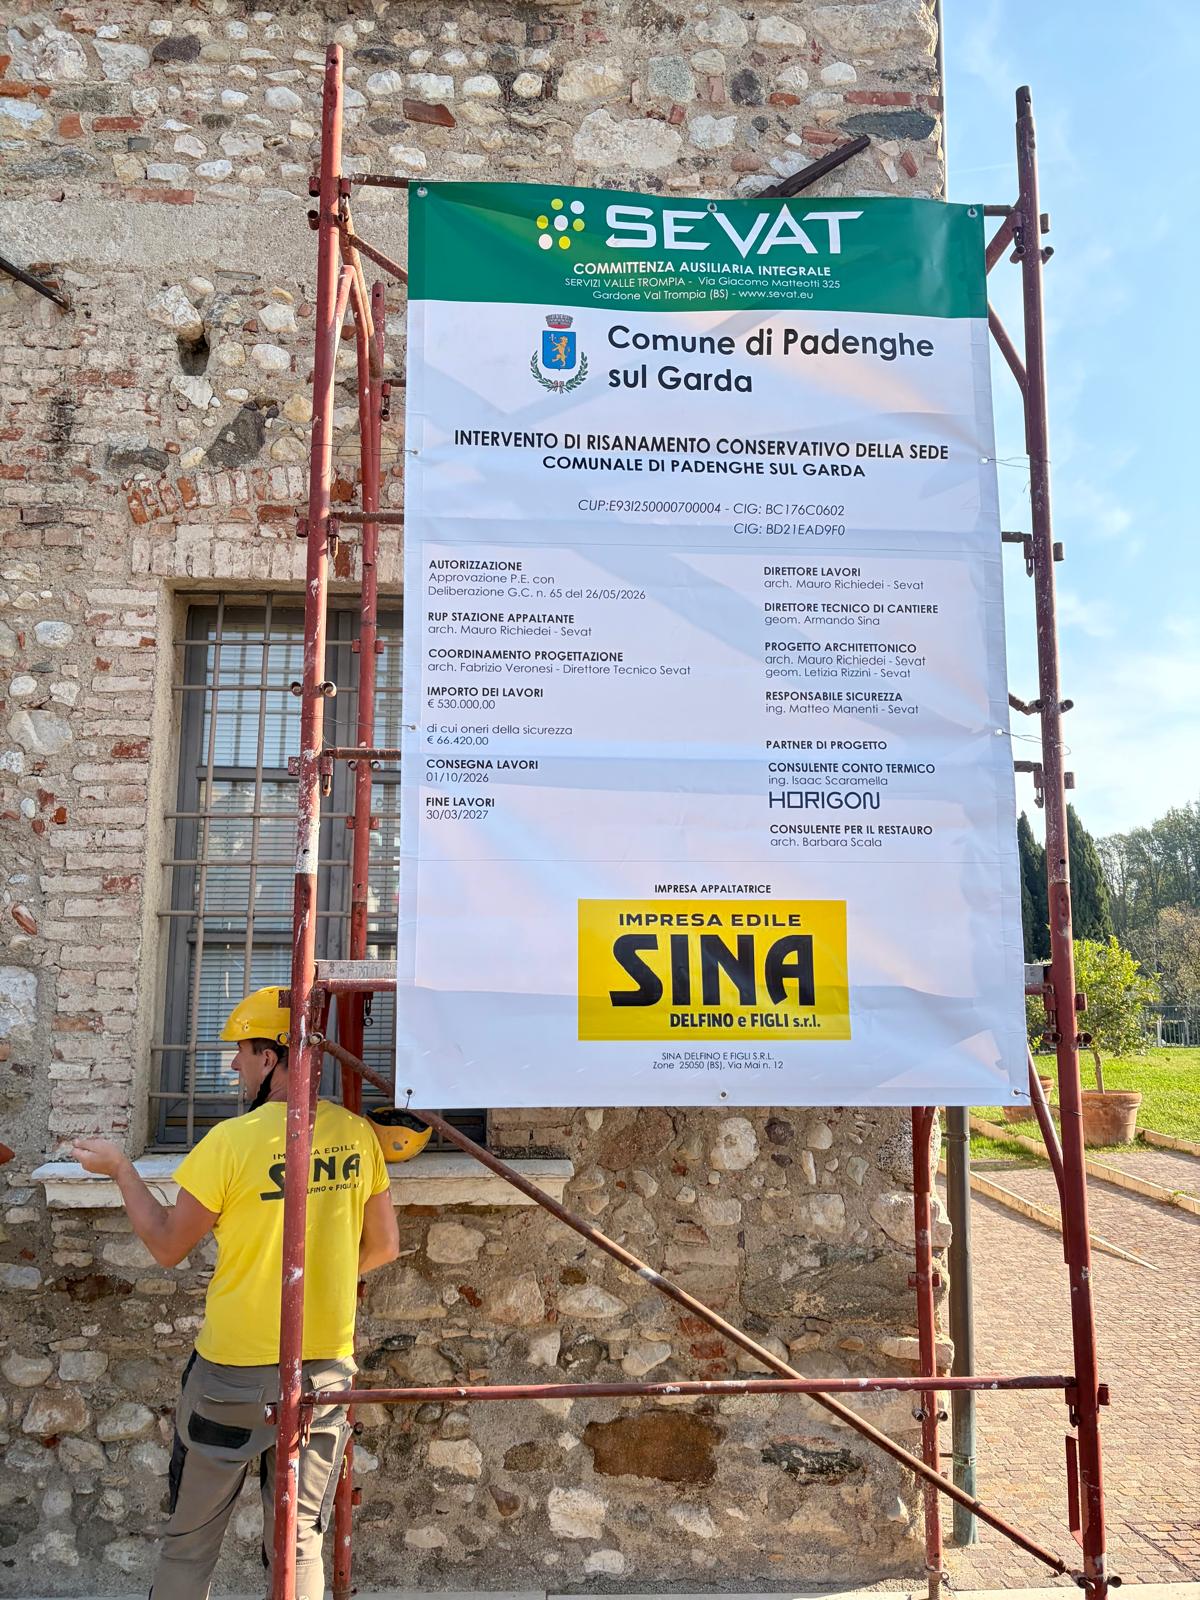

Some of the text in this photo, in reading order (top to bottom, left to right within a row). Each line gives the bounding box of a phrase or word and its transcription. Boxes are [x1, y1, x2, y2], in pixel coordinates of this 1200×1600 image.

[606, 203, 864, 258] SEVAT
[574, 262, 830, 276] COMMITTENZA AUSILIARIA INTEGRALE
[565, 278, 600, 287] SERVIZI
[604, 278, 635, 287] VALLE
[638, 277, 685, 287] TROMPIA
[698, 277, 715, 285] Via
[719, 277, 768, 286] Giacomo
[823, 280, 840, 288] 325
[593, 289, 813, 300] Gardone Val Trompia (BS) www.sevat.eu
[608, 325, 934, 361] Comune di Padenghe
[609, 364, 752, 392] sul Garda
[455, 430, 948, 459] INTERVENTO DI RISANAMENTO CONSERVATIVO DELLA SEDE
[543, 456, 865, 477] COMUNALE DI PADENGHE SUL GARDA
[734, 503, 761, 514] CIG:
[766, 504, 844, 515] BC176C0602
[734, 523, 845, 536] CIG: BD21EAD9F0
[429, 560, 522, 571] AUTORIZZAZIONE
[764, 567, 860, 576] DIRETTORE LAVORI
[429, 573, 507, 583] Approvazione
[511, 574, 529, 583] P.E.
[764, 579, 923, 589] arch. Mauro Richiedei Sevat
[428, 586, 504, 596] Deliberazione
[508, 588, 532, 597] G.C.
[550, 589, 562, 598] 65
[566, 589, 582, 598] del
[586, 589, 645, 599] 26/05/2026
[765, 603, 938, 613] DIRETTORE TECNICO DI CANTIERE
[428, 612, 574, 623] RUP STAZIONE APPALTANTE
[765, 616, 879, 626] geom. Armando Sina
[428, 625, 591, 636] arch. Mauro Richiedei Sevat
[765, 642, 916, 653] PROGETTO ARCHITETTONICO
[429, 649, 623, 662] COORDINAMENTO PROGETTAZIONE
[765, 655, 925, 666] arch. Mauro Richiedei Sevat
[428, 662, 690, 675] arch. Fabrizio Veronesi Direttore Tecnico Sevat
[766, 668, 910, 678] geom. Letizia Rizzini Sevat
[428, 687, 543, 697] IMPORTO DEI LAVORI
[766, 692, 902, 701] RESPONSABILE SICUREZZA
[428, 699, 495, 709] € 530.000,00
[766, 704, 918, 715] ing. Matteo Manenti Sevat
[427, 724, 572, 735] di cui oneri della sicurezza
[427, 736, 488, 745] € 66.420,00
[766, 741, 887, 749] PARTNER DI PROGETTO
[427, 759, 538, 769] CONSEGNA LAVORI
[768, 763, 935, 773] CONSULENTE CONTO TERMICO
[426, 772, 489, 783] 01/10/2026
[769, 775, 888, 786] ing. Isaac Scaramella
[427, 797, 494, 807] FINE LAVORI
[427, 810, 488, 820] 30/03/2027
[770, 825, 932, 835] CONSULENTE PER IL RESTAURO
[771, 837, 882, 847] arch. Barbara Scala
[655, 885, 771, 893] IMPRESA APPALTATRICE
[620, 913, 801, 926] IMPRESA EDILE
[609, 934, 815, 1007] SINA
[670, 1013, 820, 1027] DELFINO e FIGLI s.r.l.
[662, 1052, 776, 1061] SINA DELFINO E FIGLI S.R.L.
[653, 1061, 674, 1070] Zone
[679, 1061, 704, 1070] 25050
[707, 1061, 725, 1071] (BS),
[728, 1061, 746, 1070] Via
[746, 1061, 760, 1070] Mai
[775, 1061, 783, 1070] 12
[259, 1153, 360, 1201] SNA
